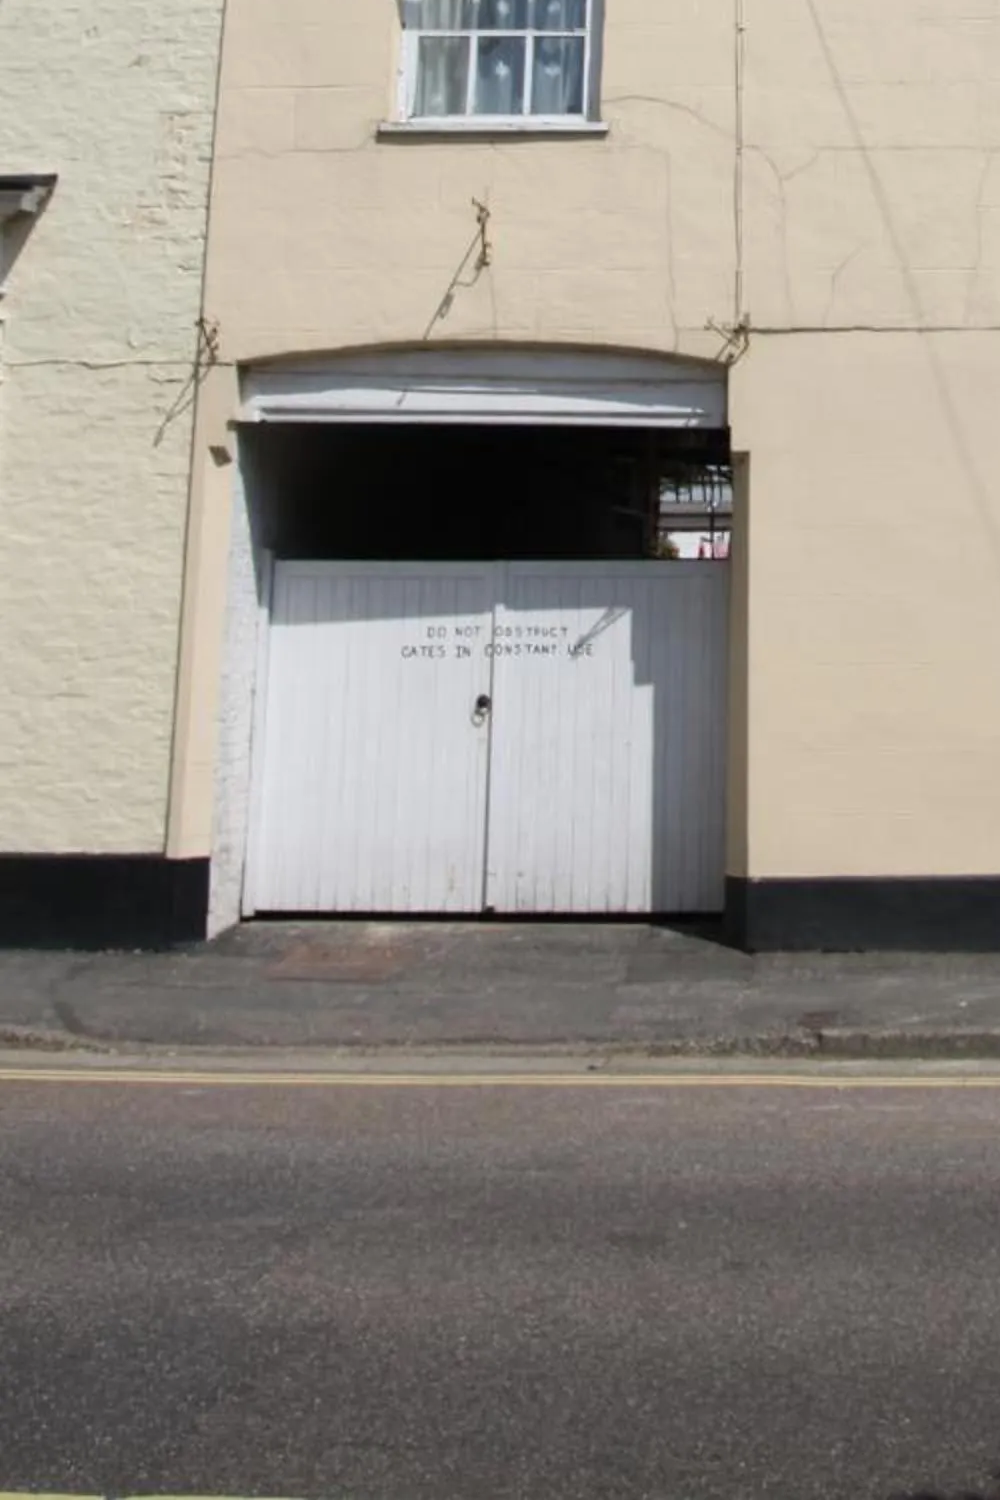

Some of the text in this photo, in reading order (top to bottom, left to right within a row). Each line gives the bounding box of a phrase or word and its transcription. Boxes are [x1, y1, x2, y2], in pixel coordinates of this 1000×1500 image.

[427, 625, 568, 638] DO NOT OBSTRUCT
[456, 645, 471, 658] IN
[484, 643, 557, 657] CONSTANT
